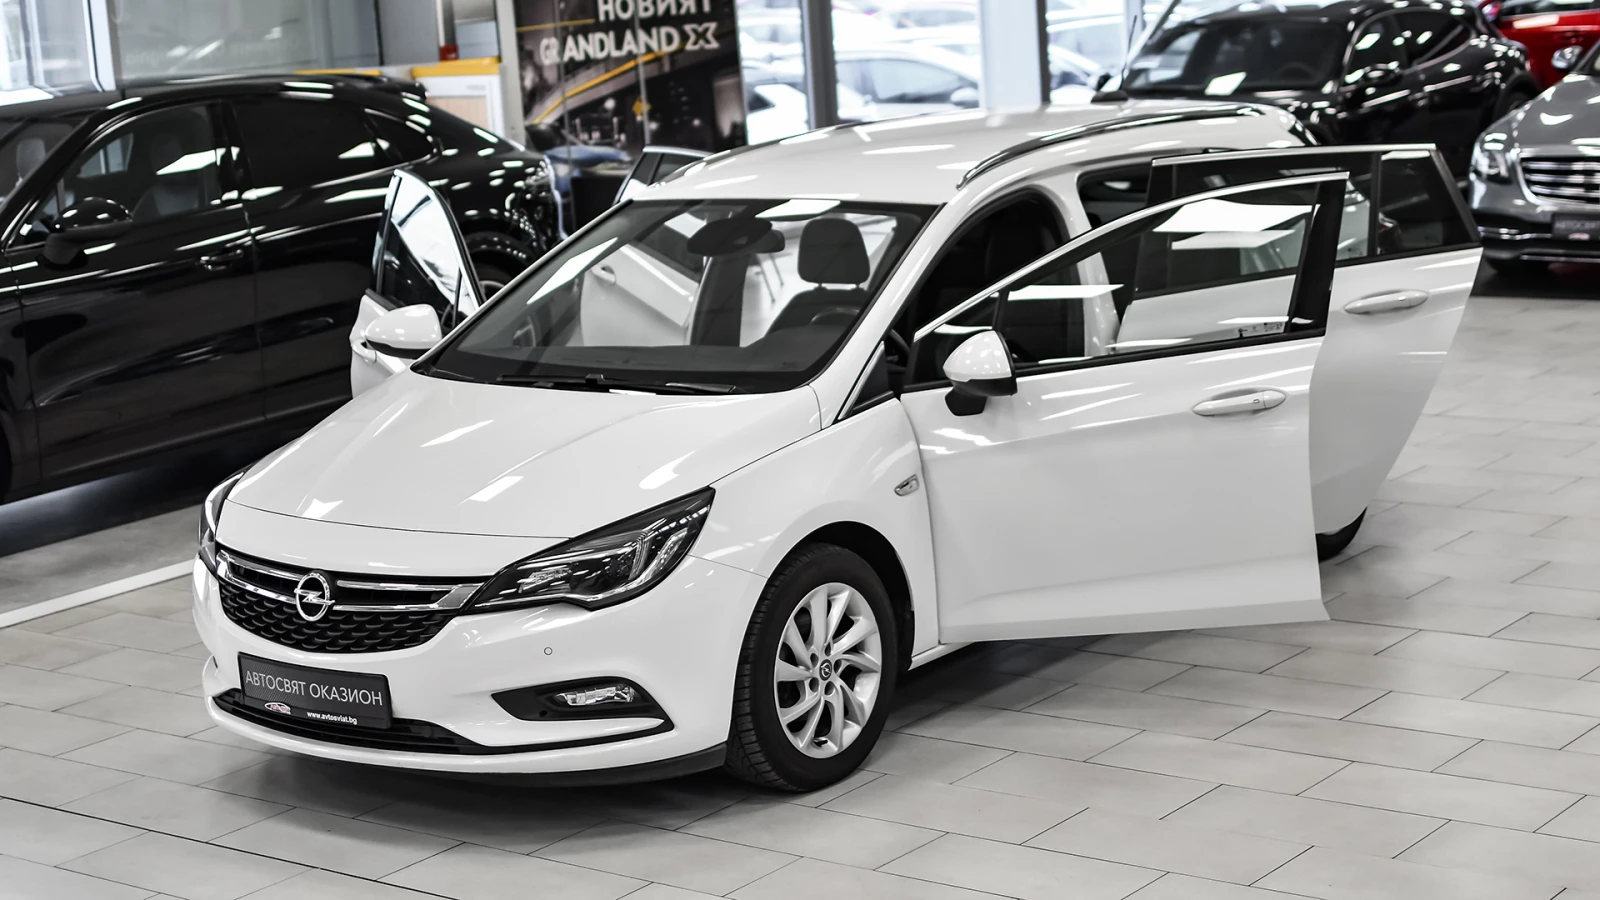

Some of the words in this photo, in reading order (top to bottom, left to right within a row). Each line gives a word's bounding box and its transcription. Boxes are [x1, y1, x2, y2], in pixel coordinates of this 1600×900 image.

[245, 670, 306, 696] АВТОСВЯТ
[309, 683, 383, 706] ОКАЗИОН
[306, 711, 358, 725] www.avtosviat.bg
